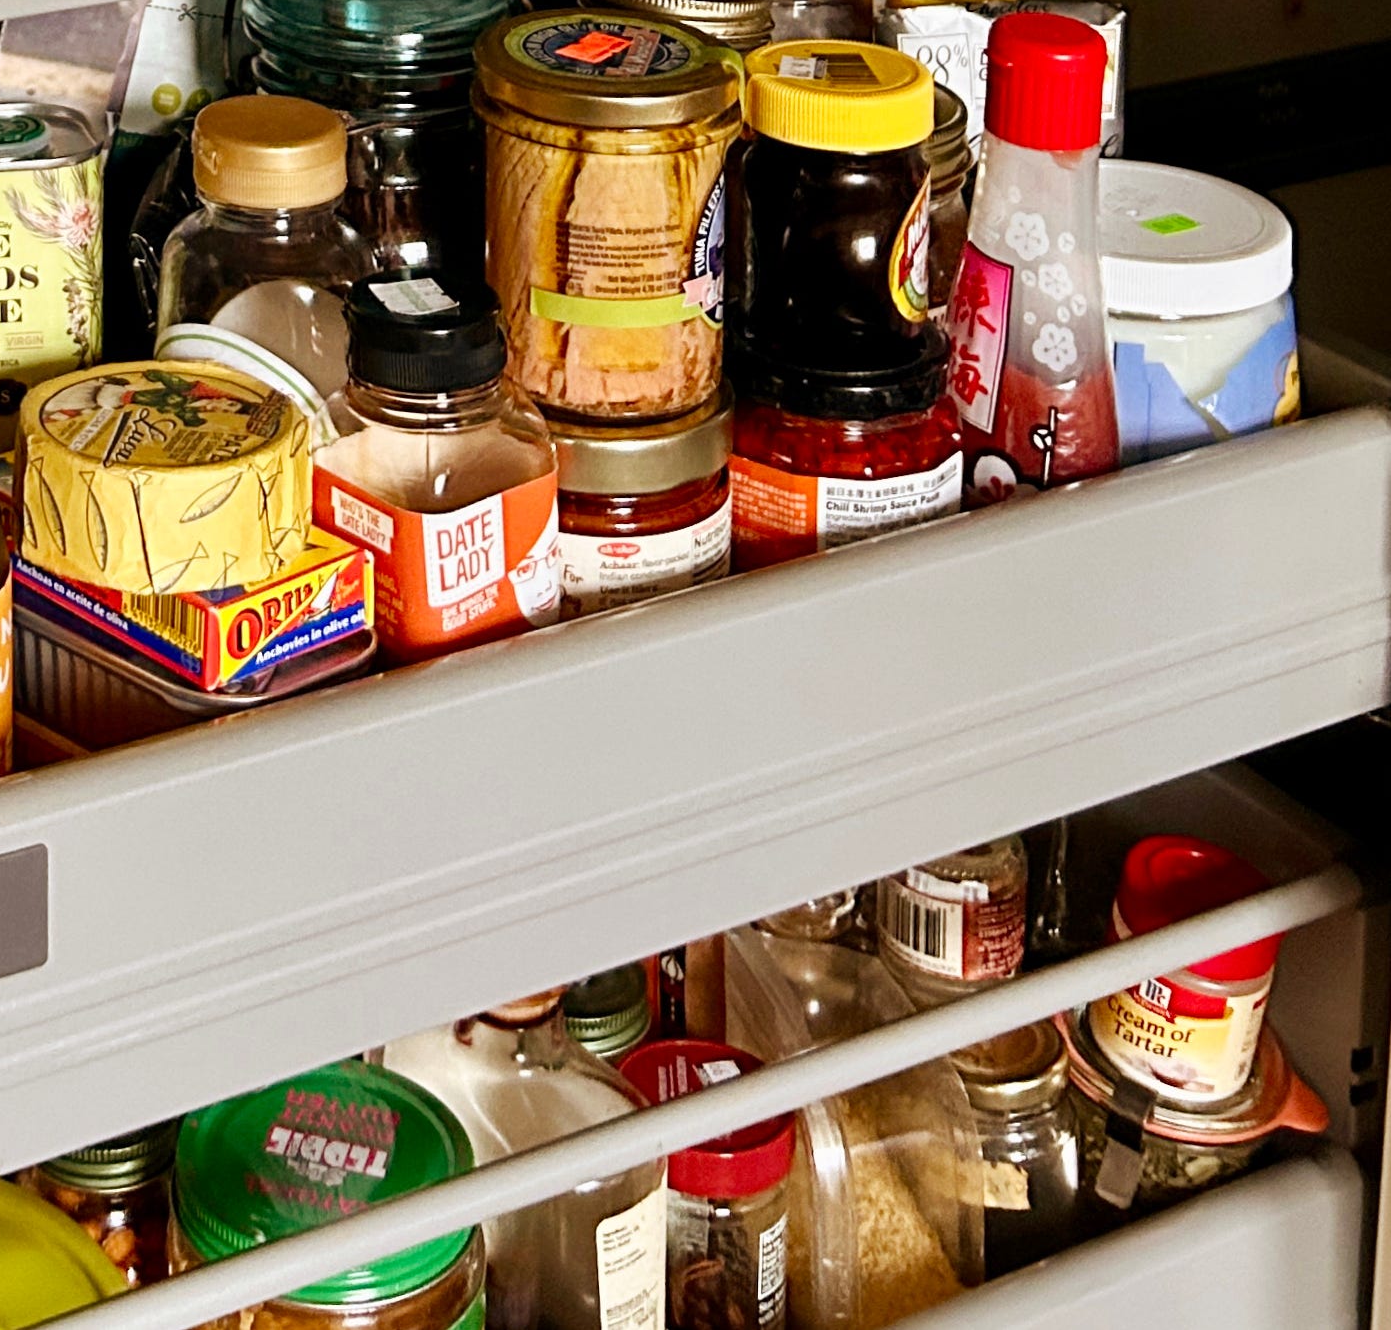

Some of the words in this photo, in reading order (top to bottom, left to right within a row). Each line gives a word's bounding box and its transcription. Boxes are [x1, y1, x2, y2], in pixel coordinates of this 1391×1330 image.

[695, 238, 706, 276] TUNA
[6, 333, 44, 347] VIRGIN
[826, 501, 850, 512] Chili
[853, 502, 887, 515] Shrimp
[890, 498, 917, 510] Sauce
[437, 509, 493, 560] DATE
[439, 540, 495, 592] LADY
[563, 564, 584, 584] For
[599, 572, 628, 581] Indian
[16, 559, 52, 587] Anchoas
[53, 581, 65, 594] en
[66, 588, 93, 611] aceite
[93, 603, 105, 617] de
[106, 610, 129, 631] oliva
[256, 632, 309, 664] Anchovies
[311, 627, 322, 640] in
[323, 617, 349, 636] olive
[351, 608, 365, 625] oil
[1108, 997, 1166, 1038] Cream
[1171, 1029, 1196, 1043] of
[1114, 1019, 1178, 1058] Tartar
[265, 1126, 388, 1179] TEDDIE
